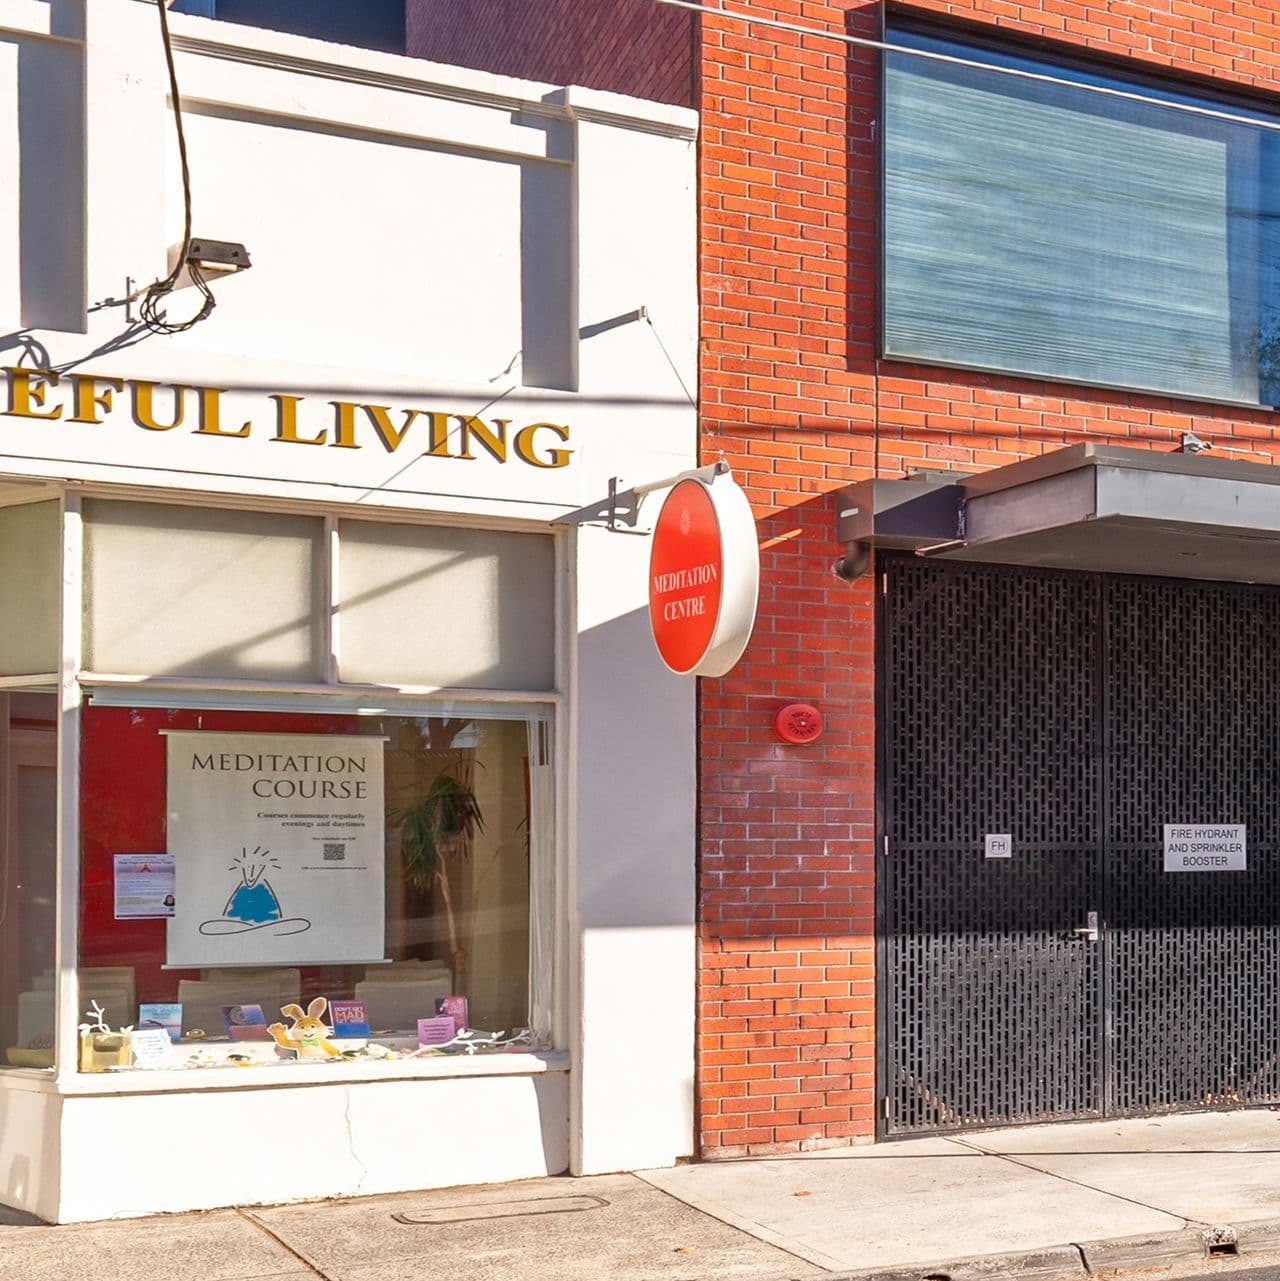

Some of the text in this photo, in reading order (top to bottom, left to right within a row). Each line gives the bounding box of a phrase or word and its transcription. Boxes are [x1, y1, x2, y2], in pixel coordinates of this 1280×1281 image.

[268, 394, 576, 469] LIVING
[654, 562, 718, 593] MEDITATION
[663, 595, 706, 622] CENTRE
[191, 753, 367, 773] MEDITATION
[252, 779, 367, 799] COURSE
[257, 812, 289, 820] Courses
[1171, 829, 1239, 839] FIRE HYDRANT
[991, 841, 1006, 850] FH
[1168, 843, 1242, 853] AND SPRINKLER
[1182, 856, 1228, 866] BOOSTER
[335, 1011, 363, 1019] MAD
